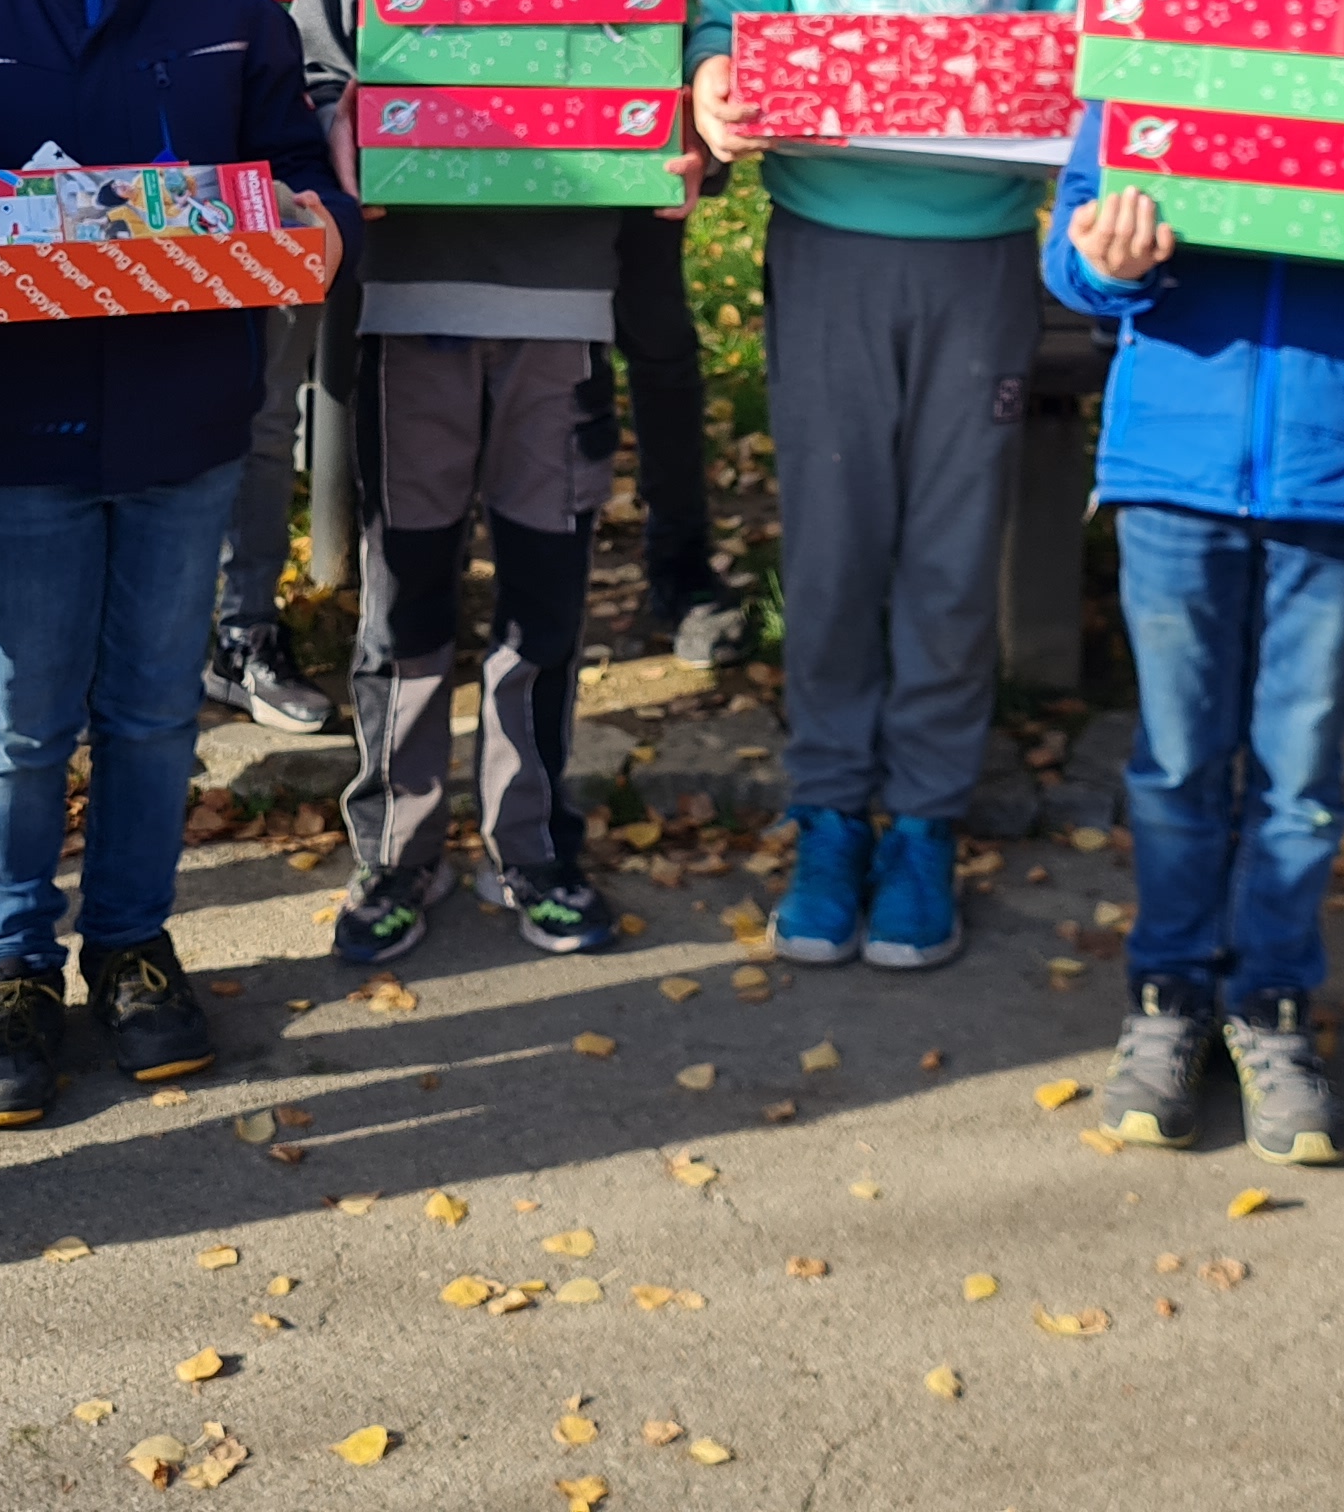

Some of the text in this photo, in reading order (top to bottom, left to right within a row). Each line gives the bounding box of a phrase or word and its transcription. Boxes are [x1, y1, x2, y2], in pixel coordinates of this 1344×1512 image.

[270, 230, 306, 257] aper
[50, 249, 95, 290] Paper
[129, 262, 173, 303] Paper
[229, 240, 285, 297] Copying
[15, 273, 71, 320] Copyin
[205, 274, 244, 308] Pape
